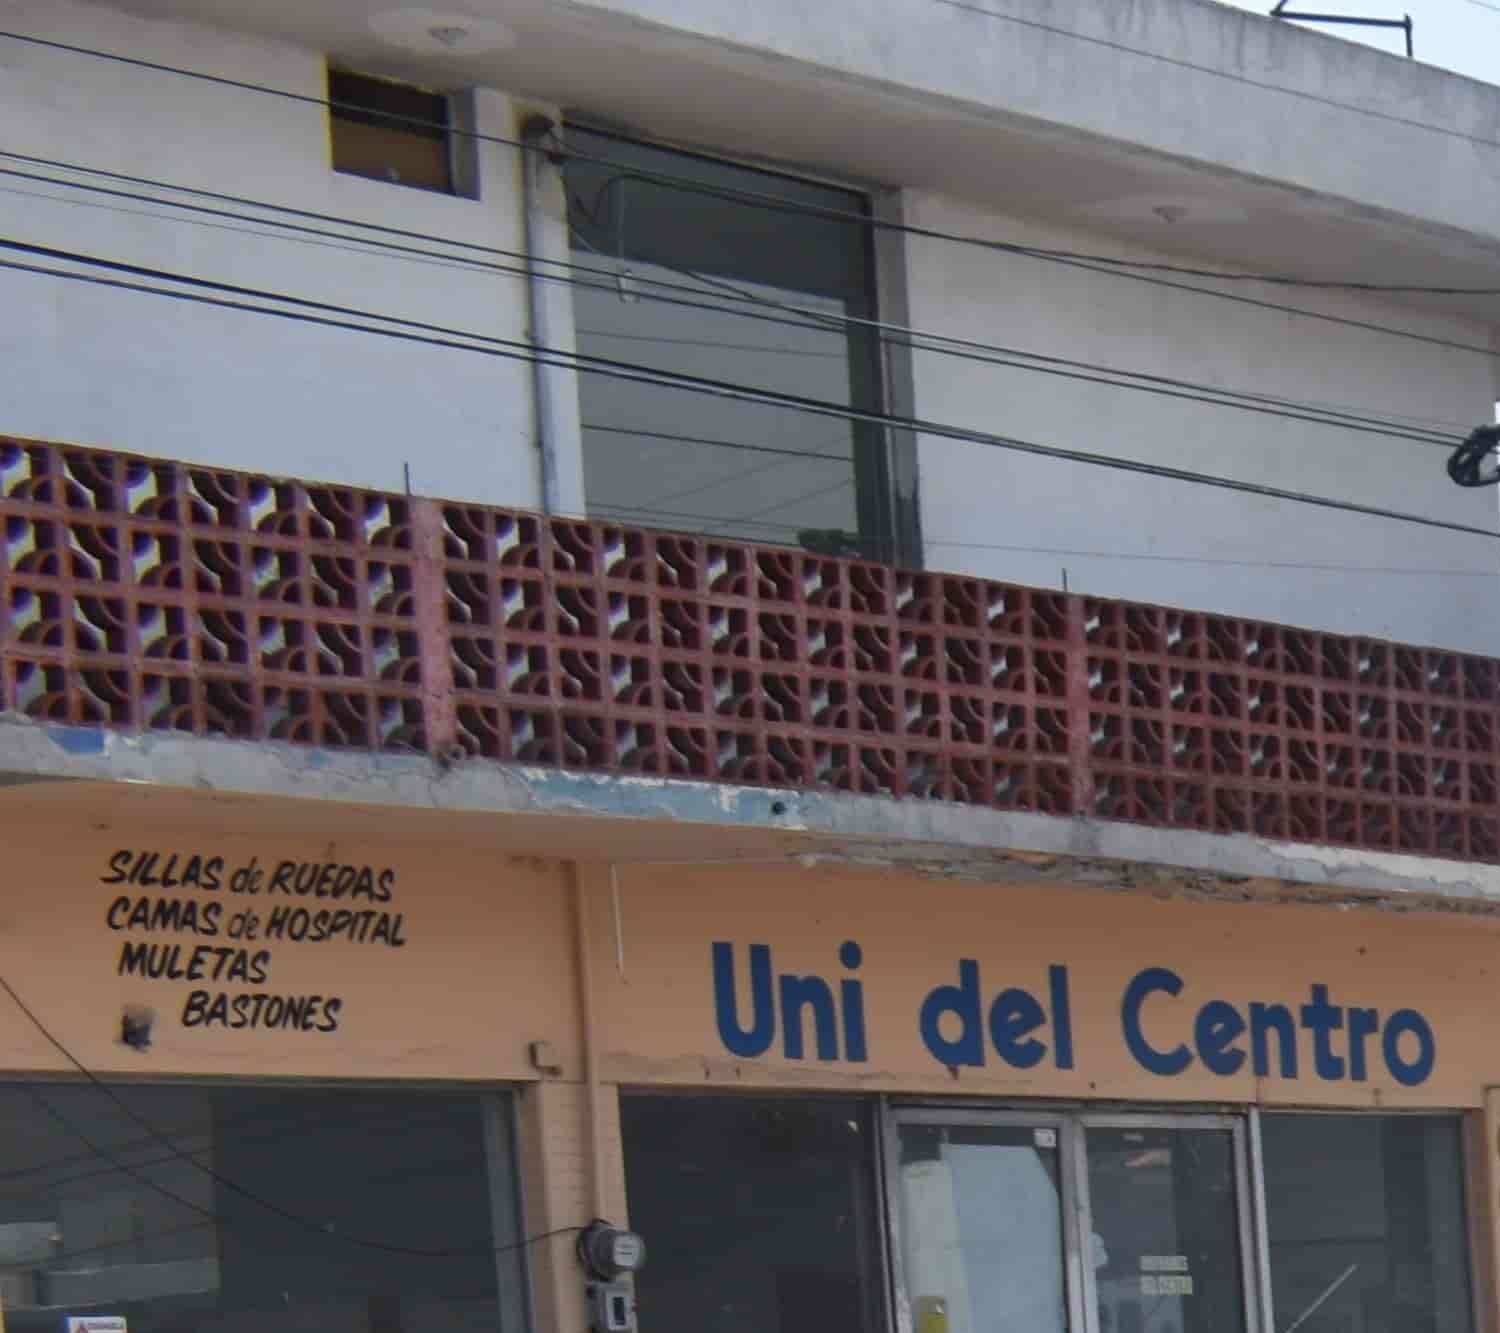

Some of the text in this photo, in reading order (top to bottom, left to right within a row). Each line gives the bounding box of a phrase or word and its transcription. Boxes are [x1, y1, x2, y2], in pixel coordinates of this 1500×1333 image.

[100, 850, 394, 902] SILLAS de RUEDAS
[106, 896, 406, 947] CAMAS de HOSPITAL
[118, 942, 271, 984] MULETAS
[182, 990, 343, 1032] BASTONES
[711, 940, 1435, 1087] Uni del Centro
